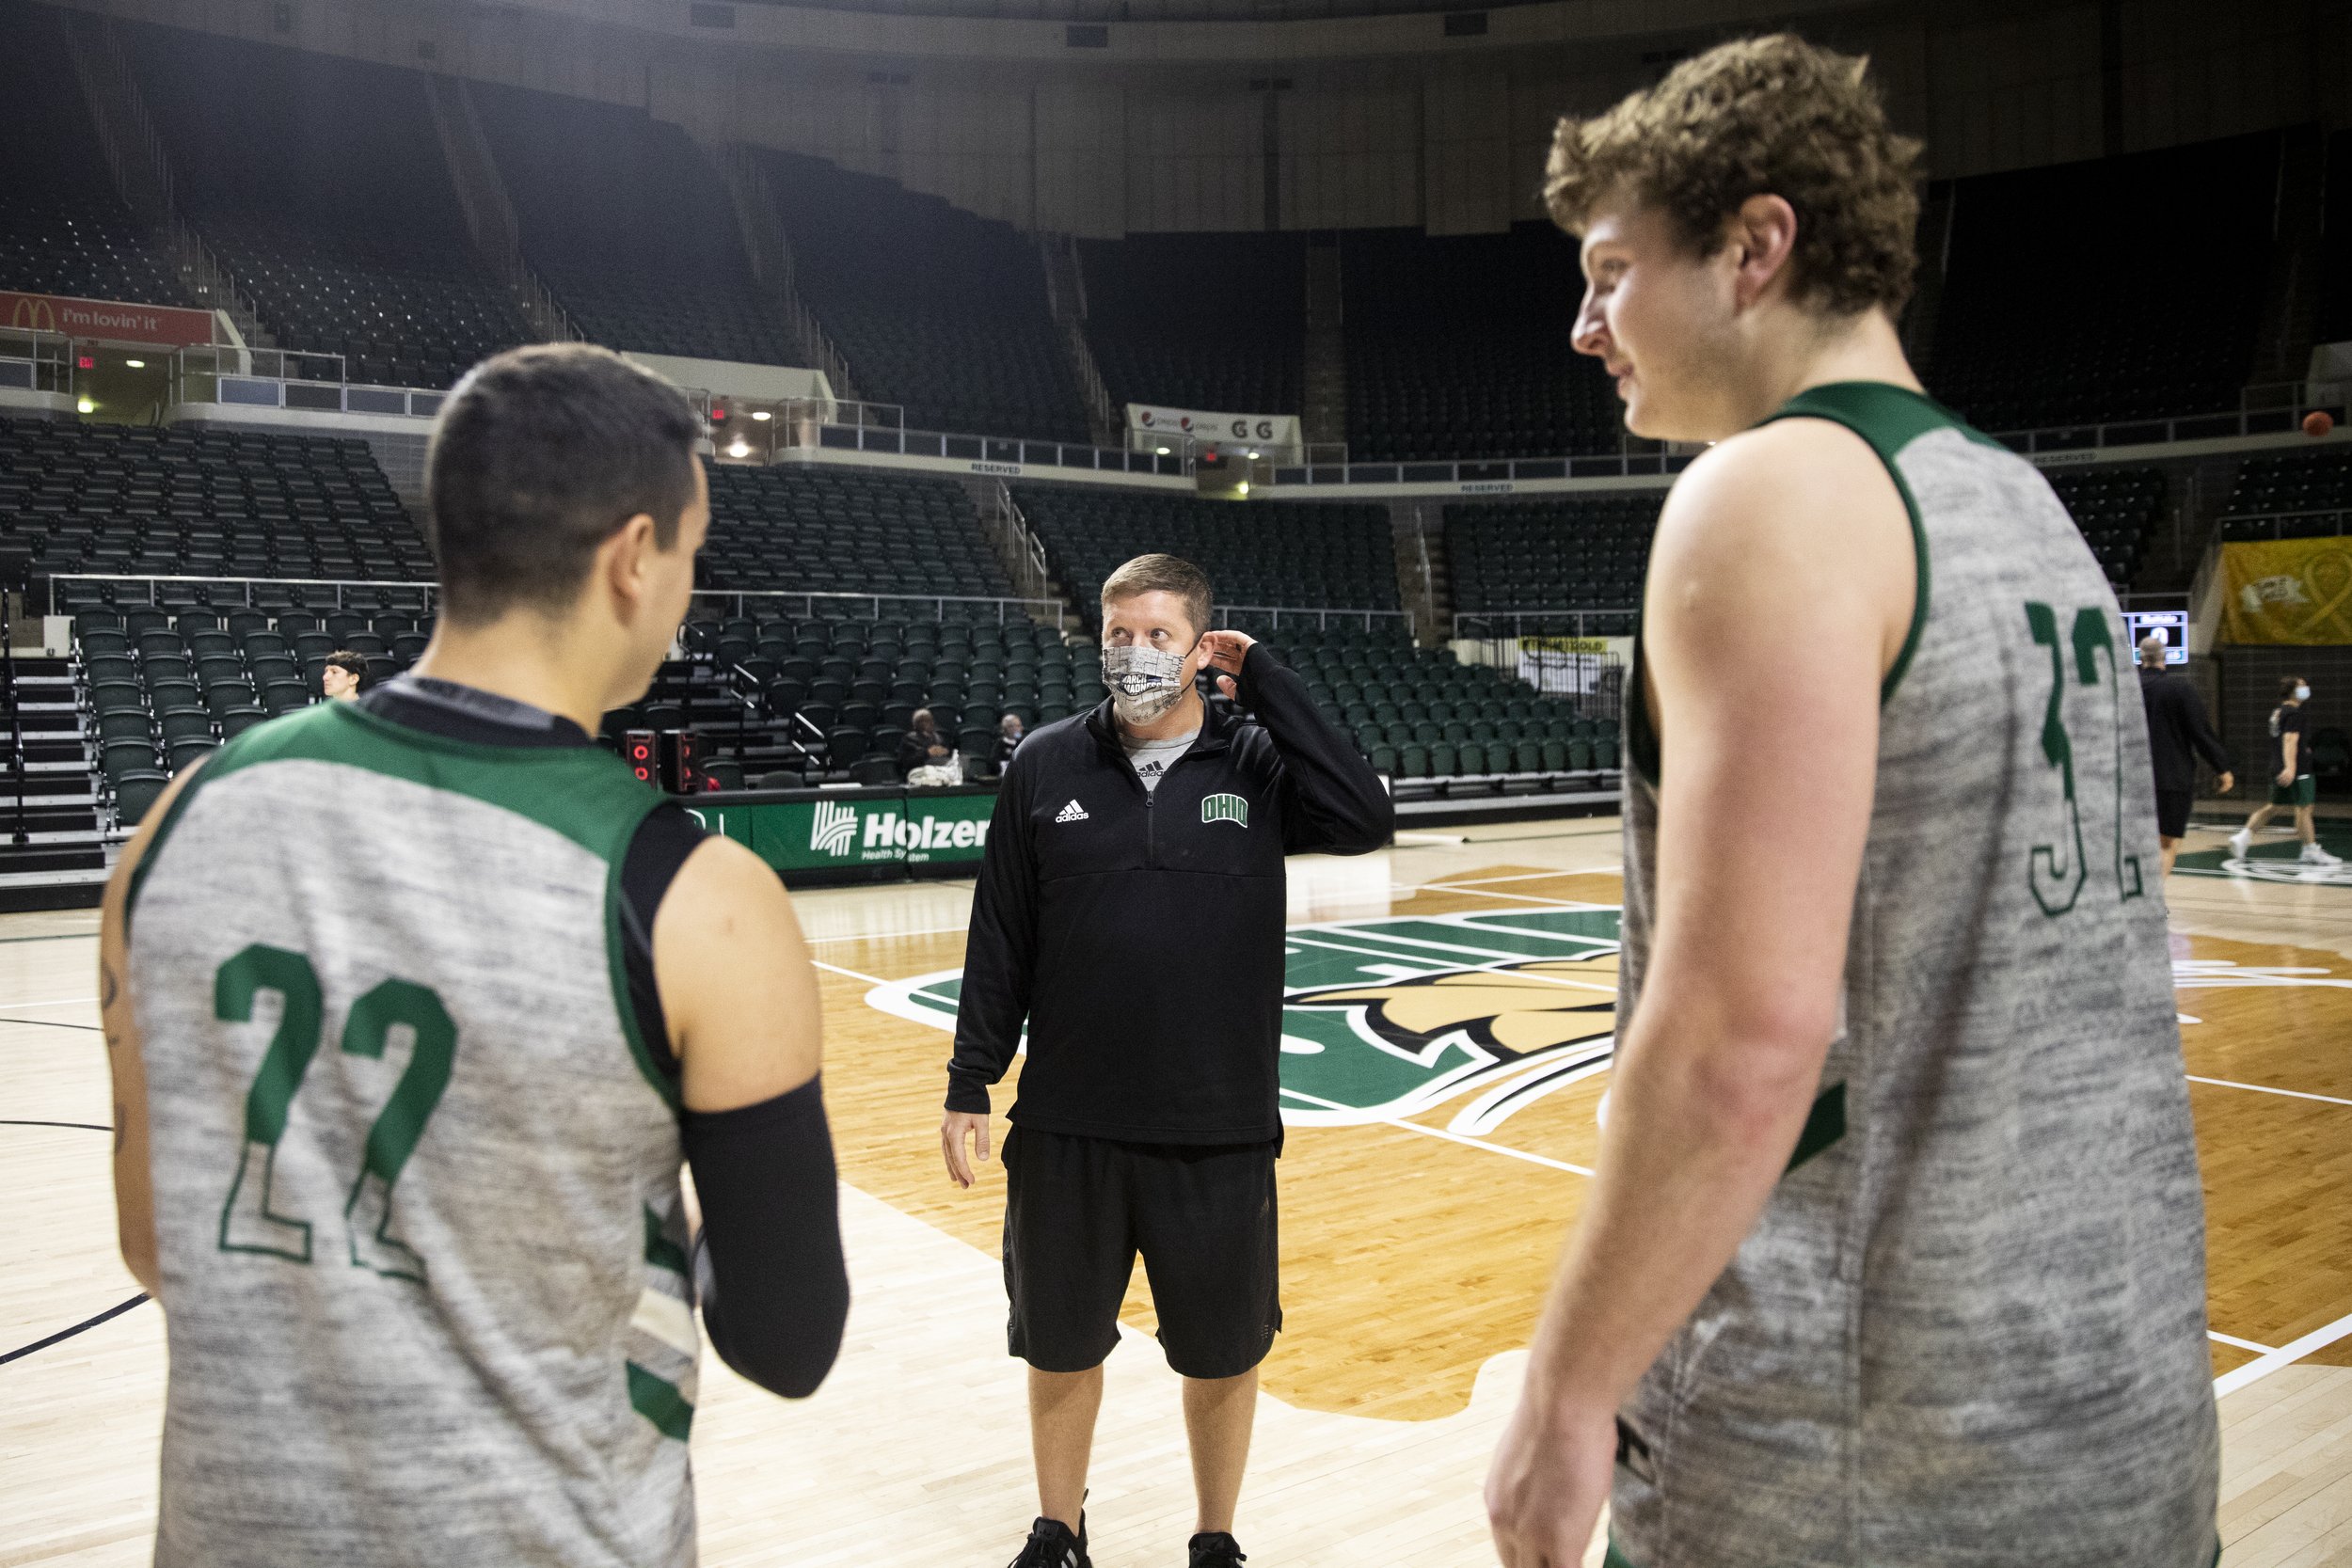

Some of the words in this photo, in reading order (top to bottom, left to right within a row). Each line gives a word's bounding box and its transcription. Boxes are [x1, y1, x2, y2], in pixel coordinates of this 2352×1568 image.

[62, 308, 90, 324] i'm
[93, 310, 141, 329] lovin'
[144, 315, 157, 330] it
[971, 462, 1021, 475] RESERVED
[1461, 483, 1514, 494] RESERVED
[1056, 811, 1089, 823] adidas
[1202, 793, 1248, 828] OHIO
[864, 812, 991, 851] Holzer
[862, 849, 893, 861] Health
[215, 942, 458, 1286] 22
